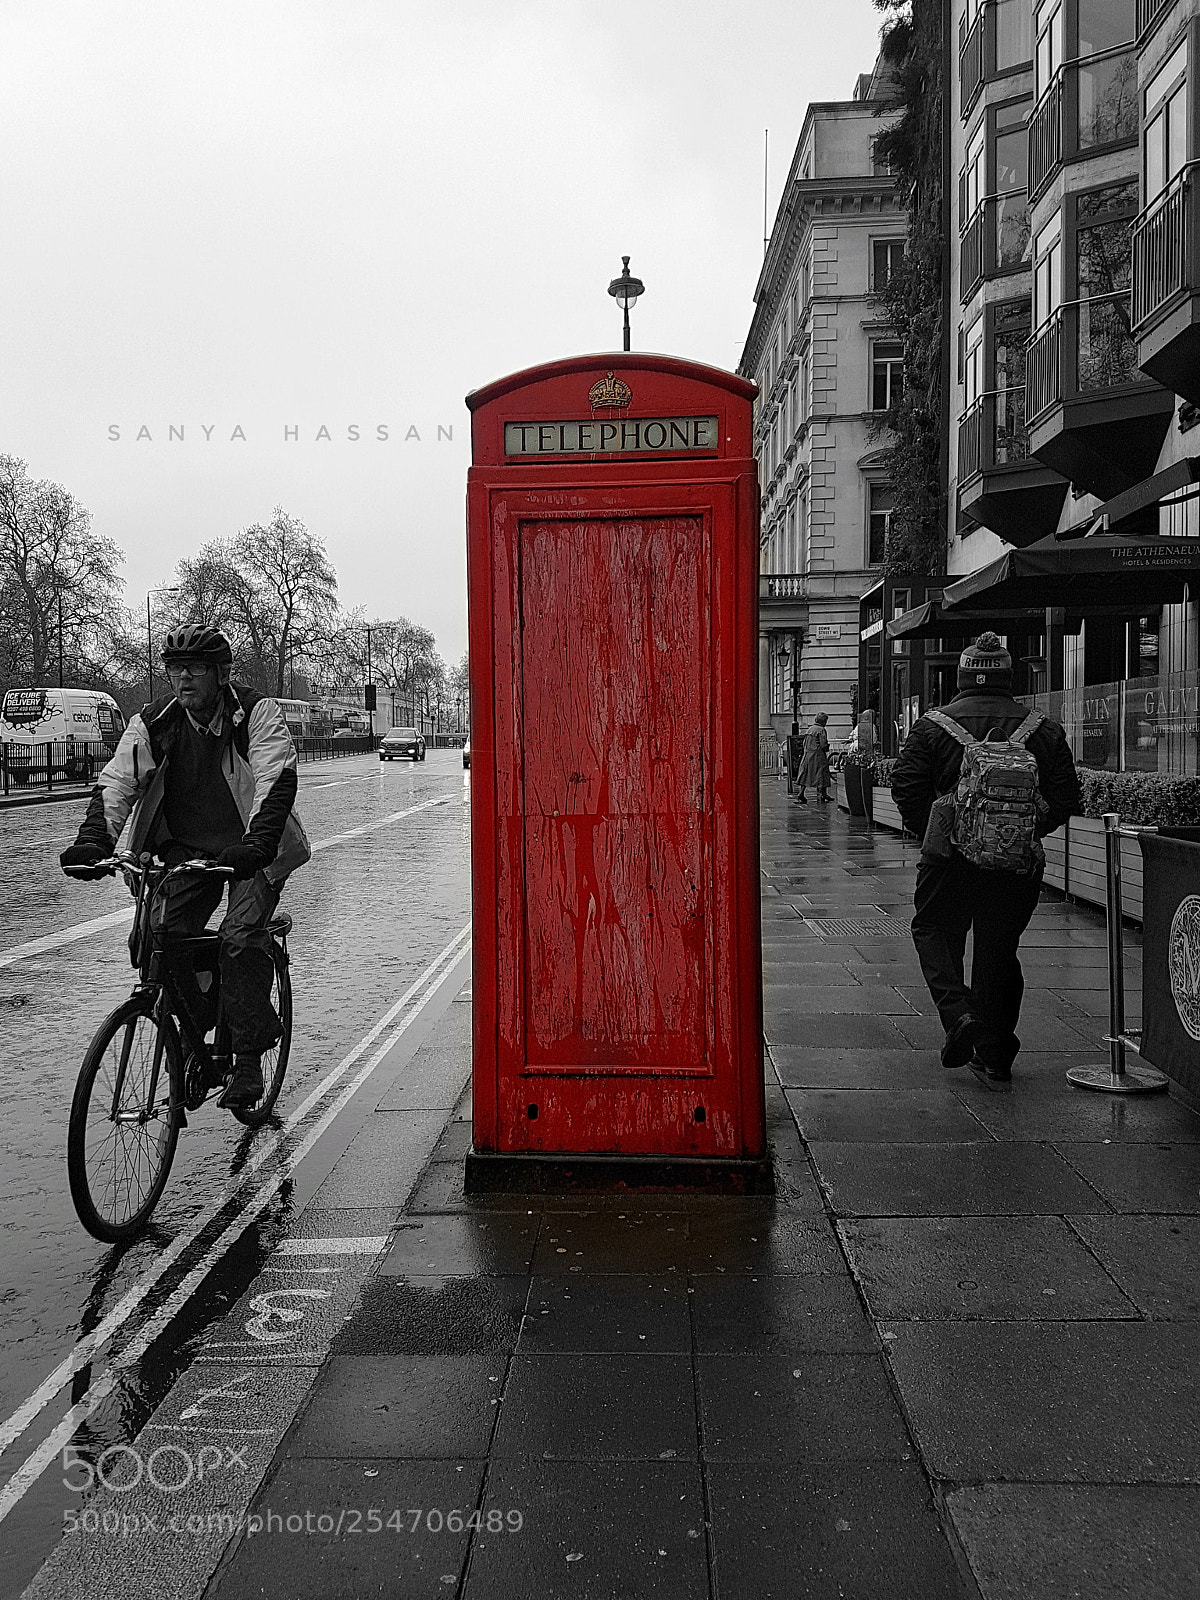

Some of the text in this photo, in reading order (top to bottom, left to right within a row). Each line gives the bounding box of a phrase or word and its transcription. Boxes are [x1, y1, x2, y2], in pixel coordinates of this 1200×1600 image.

[512, 420, 710, 452] TELEPHONE
[1110, 548, 1134, 557] THE
[964, 657, 1001, 668] RAMS
[7, 692, 20, 700] ICE
[1144, 686, 1200, 715] GALVI
[7, 698, 41, 706] DELIVERY
